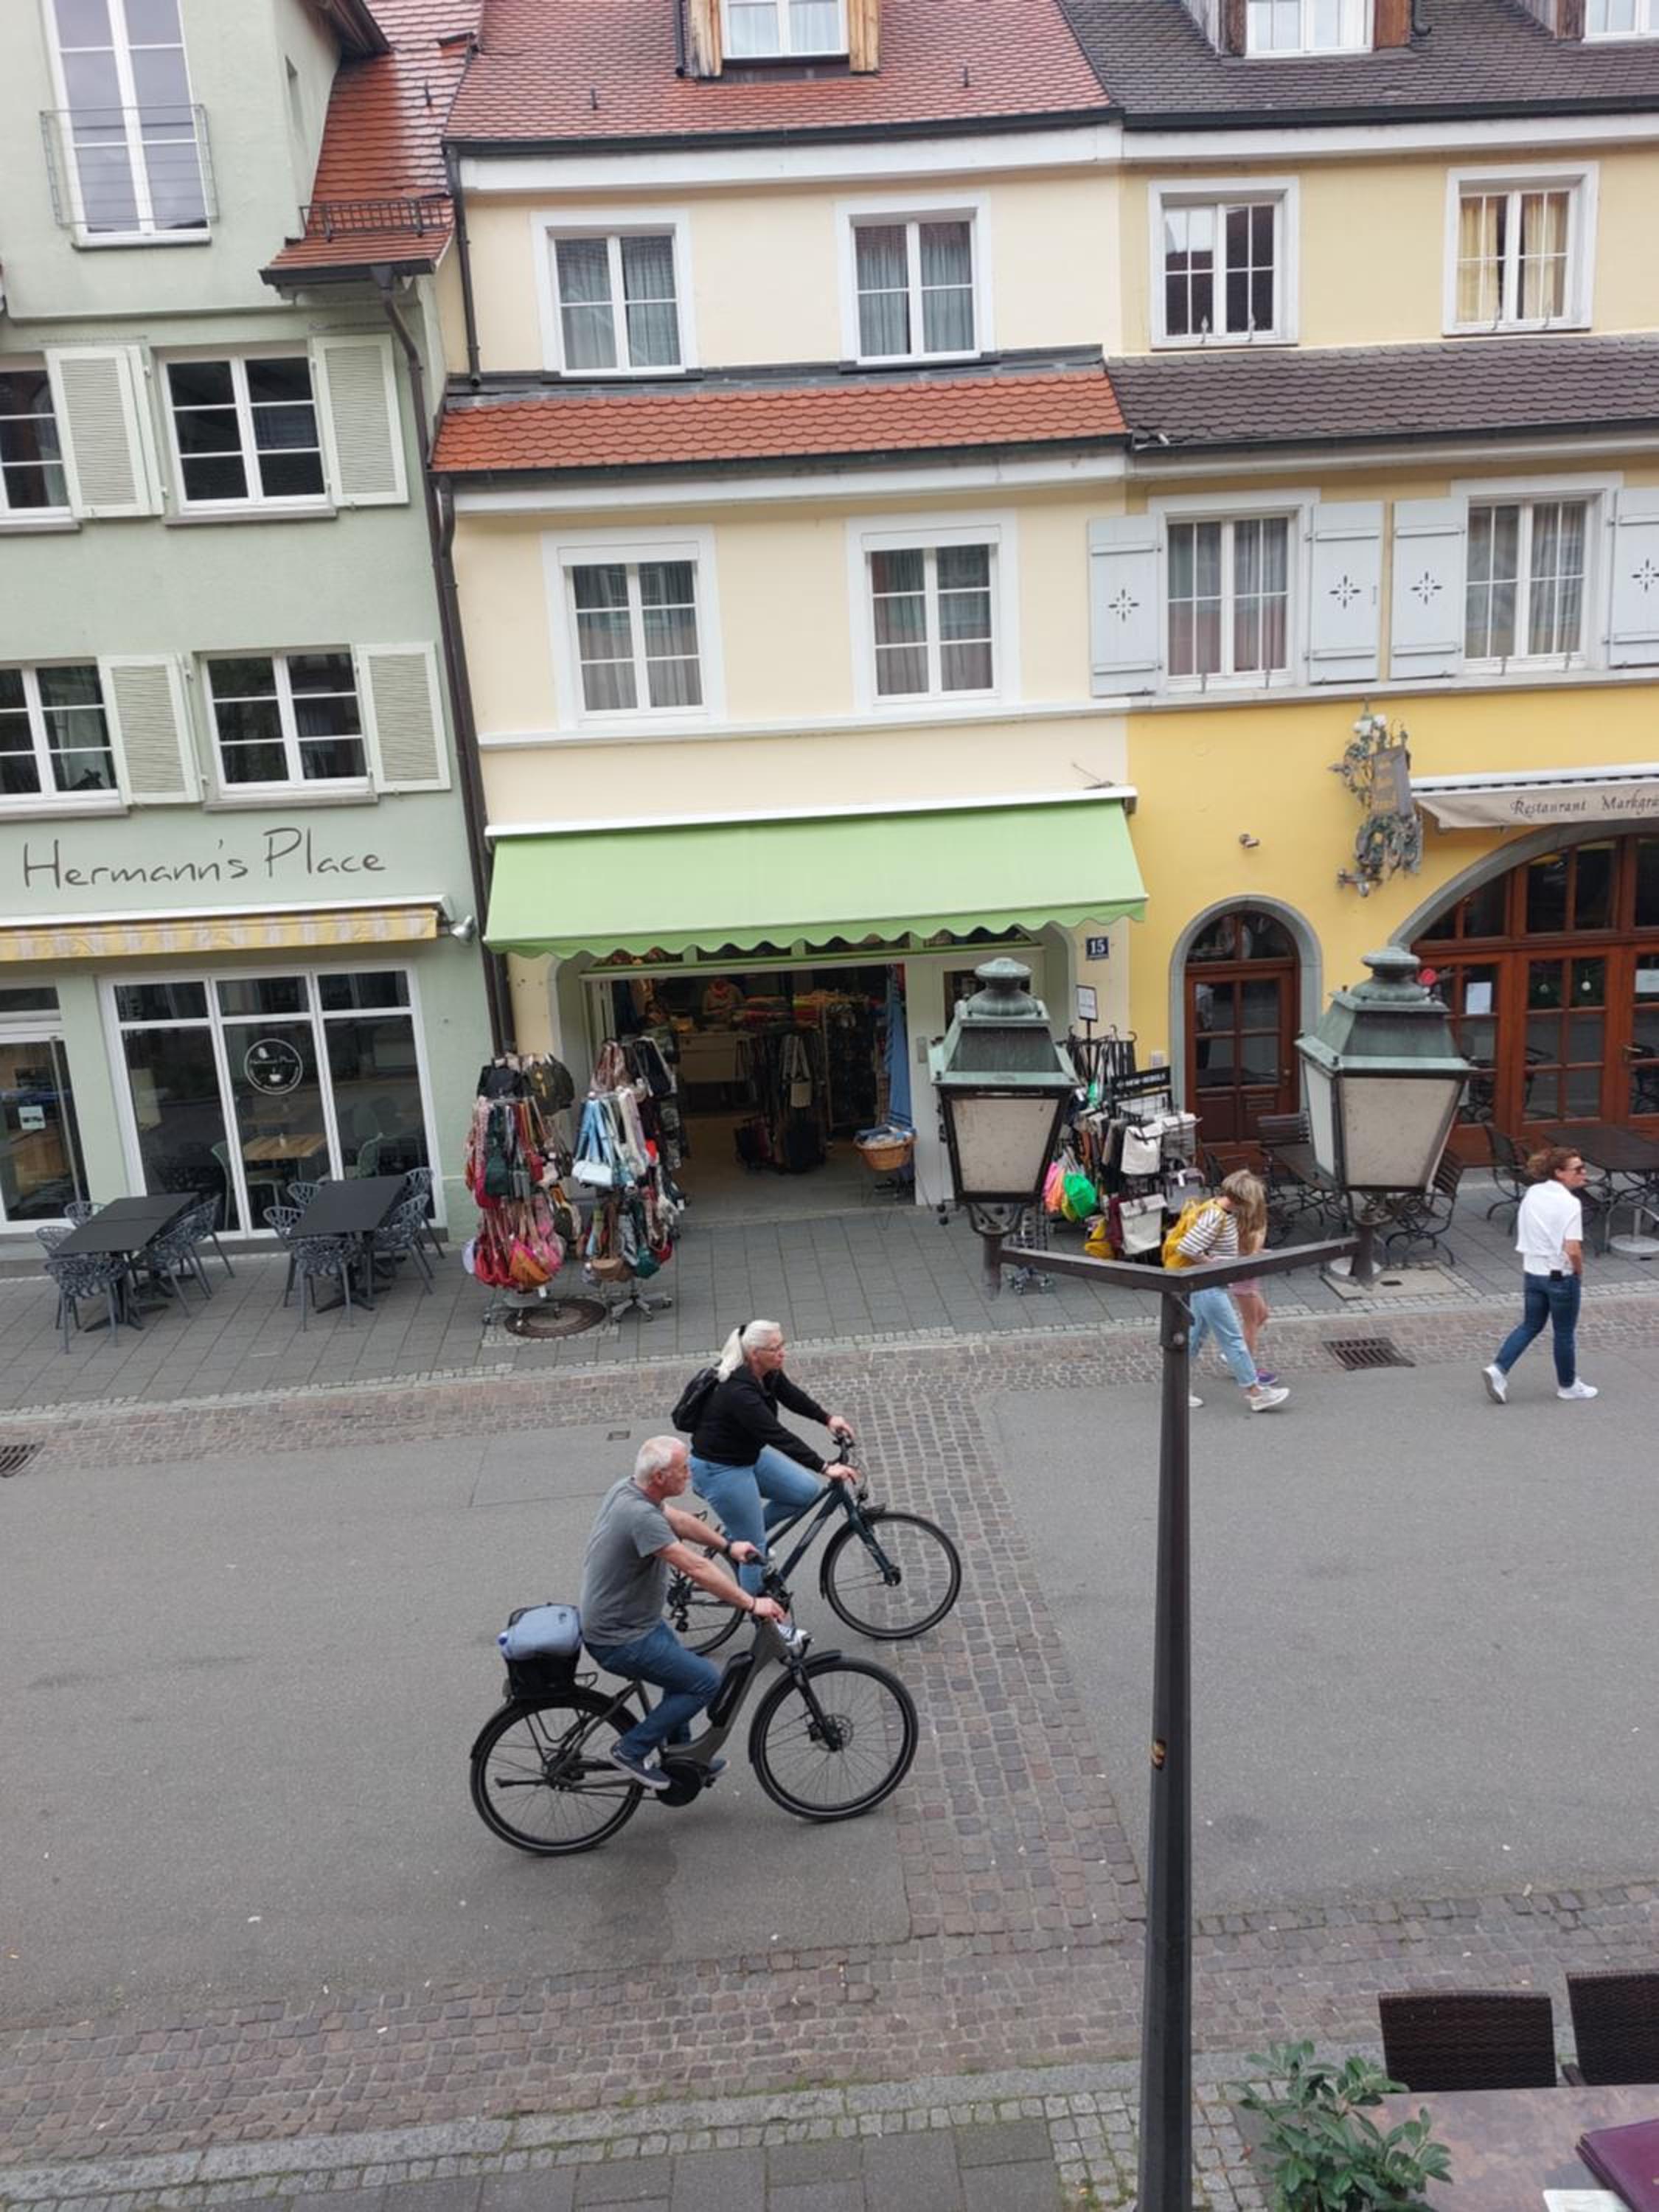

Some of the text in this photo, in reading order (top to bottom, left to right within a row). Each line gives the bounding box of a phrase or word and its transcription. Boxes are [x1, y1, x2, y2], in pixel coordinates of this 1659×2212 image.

[1510, 796, 1587, 818] Restaurant
[23, 826, 387, 889] Hermann's Place
[1089, 939, 1106, 954] 15
